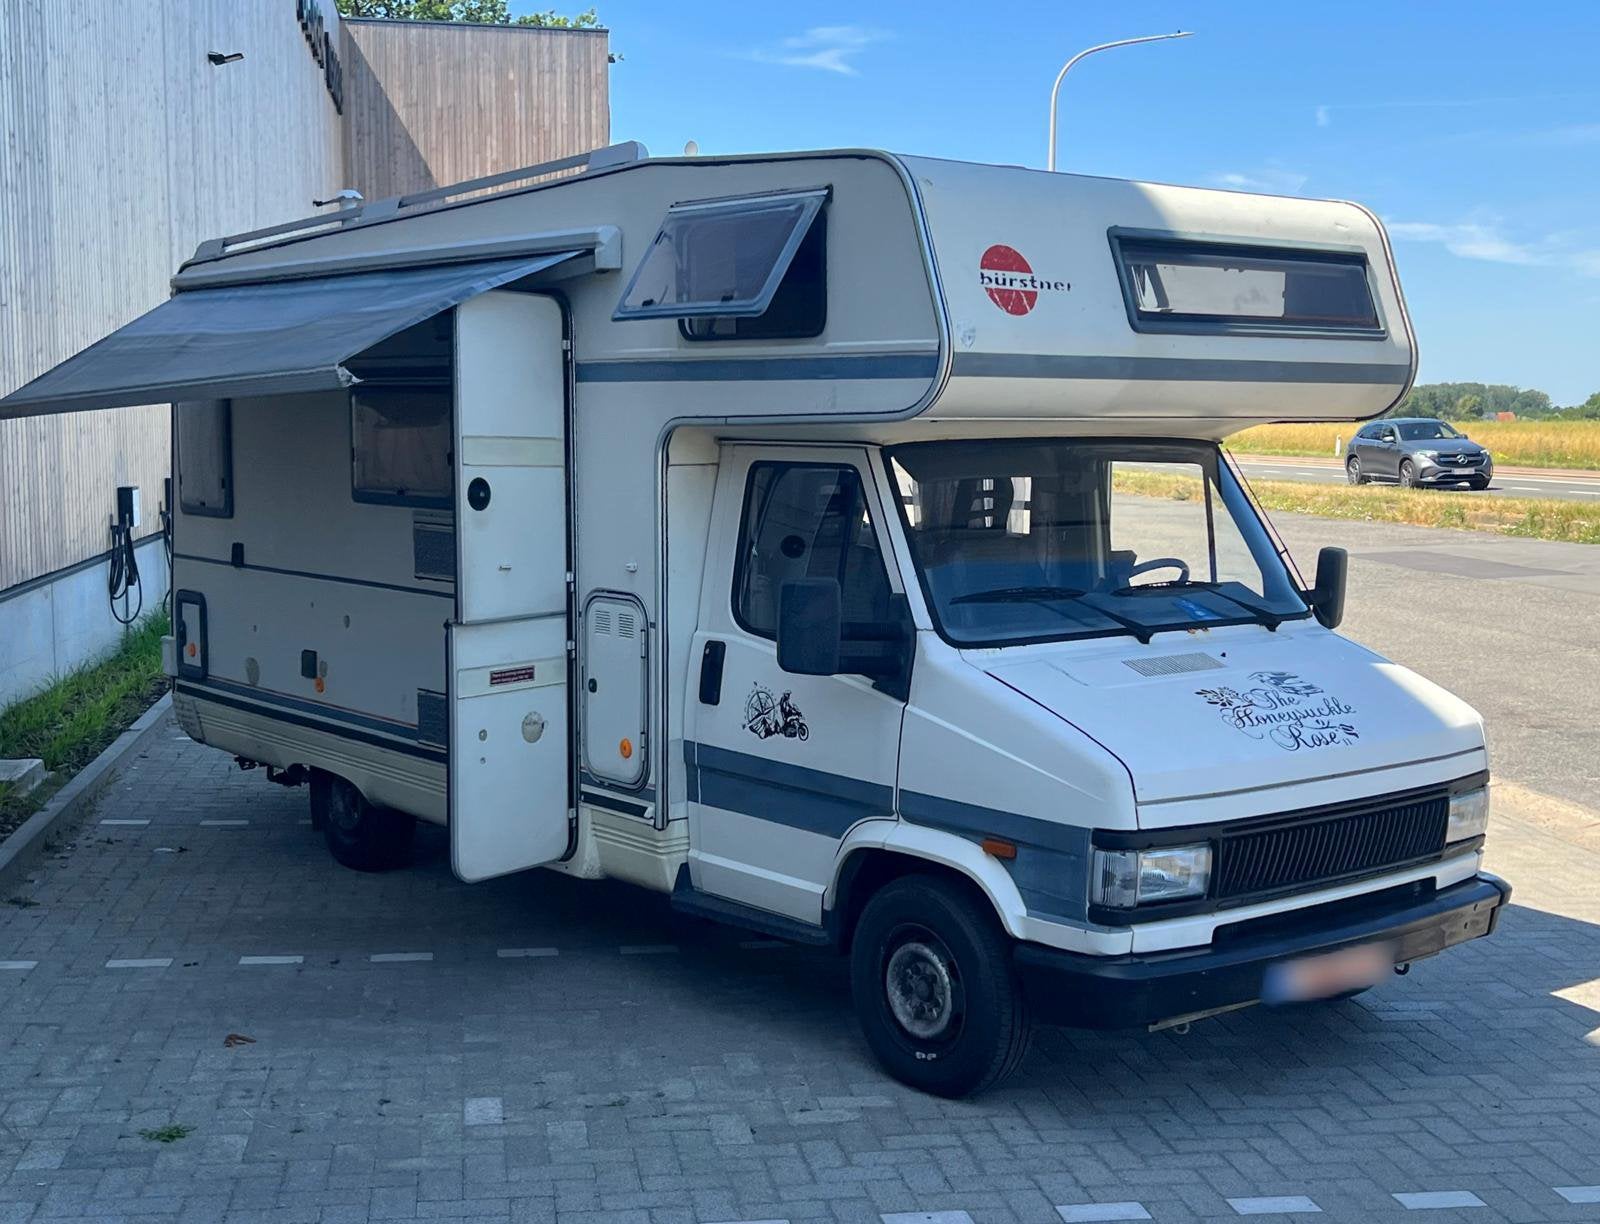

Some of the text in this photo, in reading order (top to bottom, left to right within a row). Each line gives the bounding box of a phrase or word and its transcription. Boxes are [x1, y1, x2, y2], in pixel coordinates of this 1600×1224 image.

[1247, 688, 1301, 710] The
[1221, 697, 1358, 737] Honeysuckle
[1270, 723, 1341, 751] Rose
